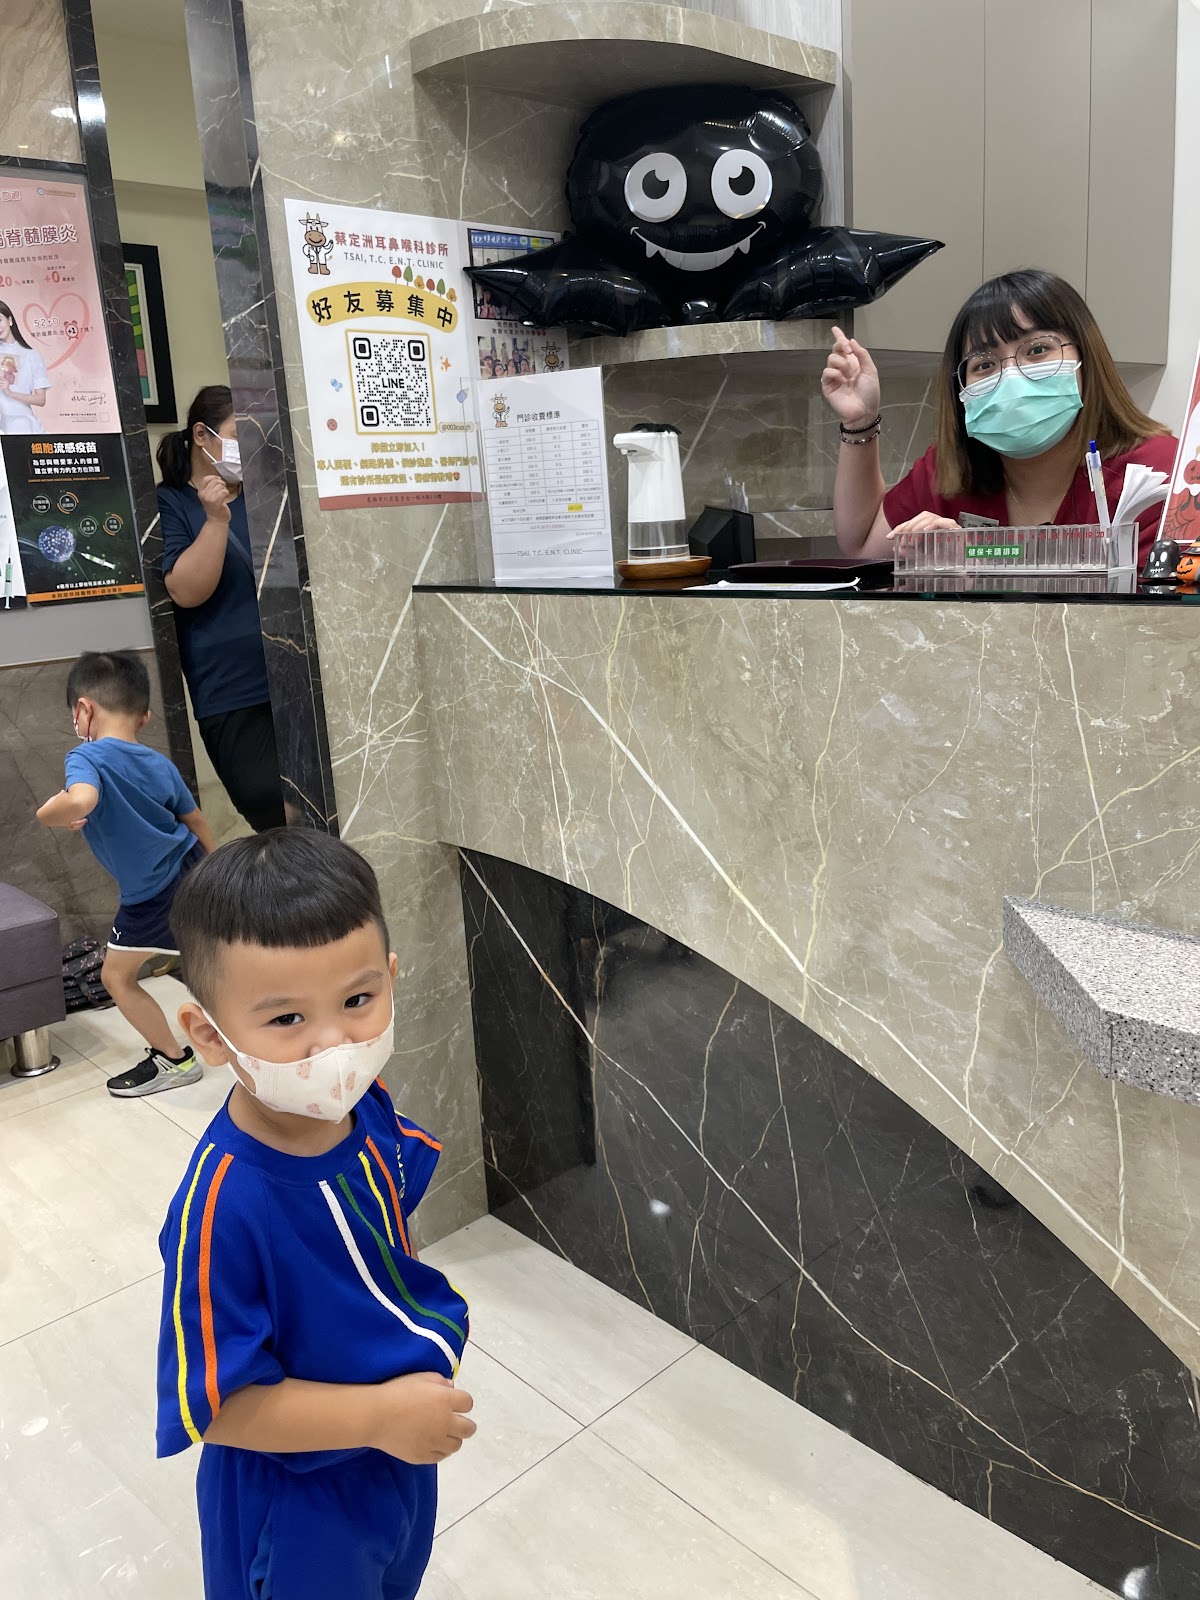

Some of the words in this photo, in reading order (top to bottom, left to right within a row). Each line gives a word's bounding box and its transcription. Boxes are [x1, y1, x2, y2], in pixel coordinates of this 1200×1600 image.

[335, 231, 449, 257] 蔡定洲耳鼻喉科診所
[344, 252, 367, 264] TSAI,
[369, 254, 386, 264] T.C.
[389, 256, 415, 267] E.N.T.
[417, 259, 444, 269] CLINIC
[312, 289, 453, 328] 好友募集中
[34, 317, 59, 327] 52+0
[382, 378, 405, 389] LINE
[517, 410, 561, 423] 門診收費標準
[31, 442, 97, 454] 細胞流感疫苗
[968, 548, 1020, 556] 健保卡請排隊
